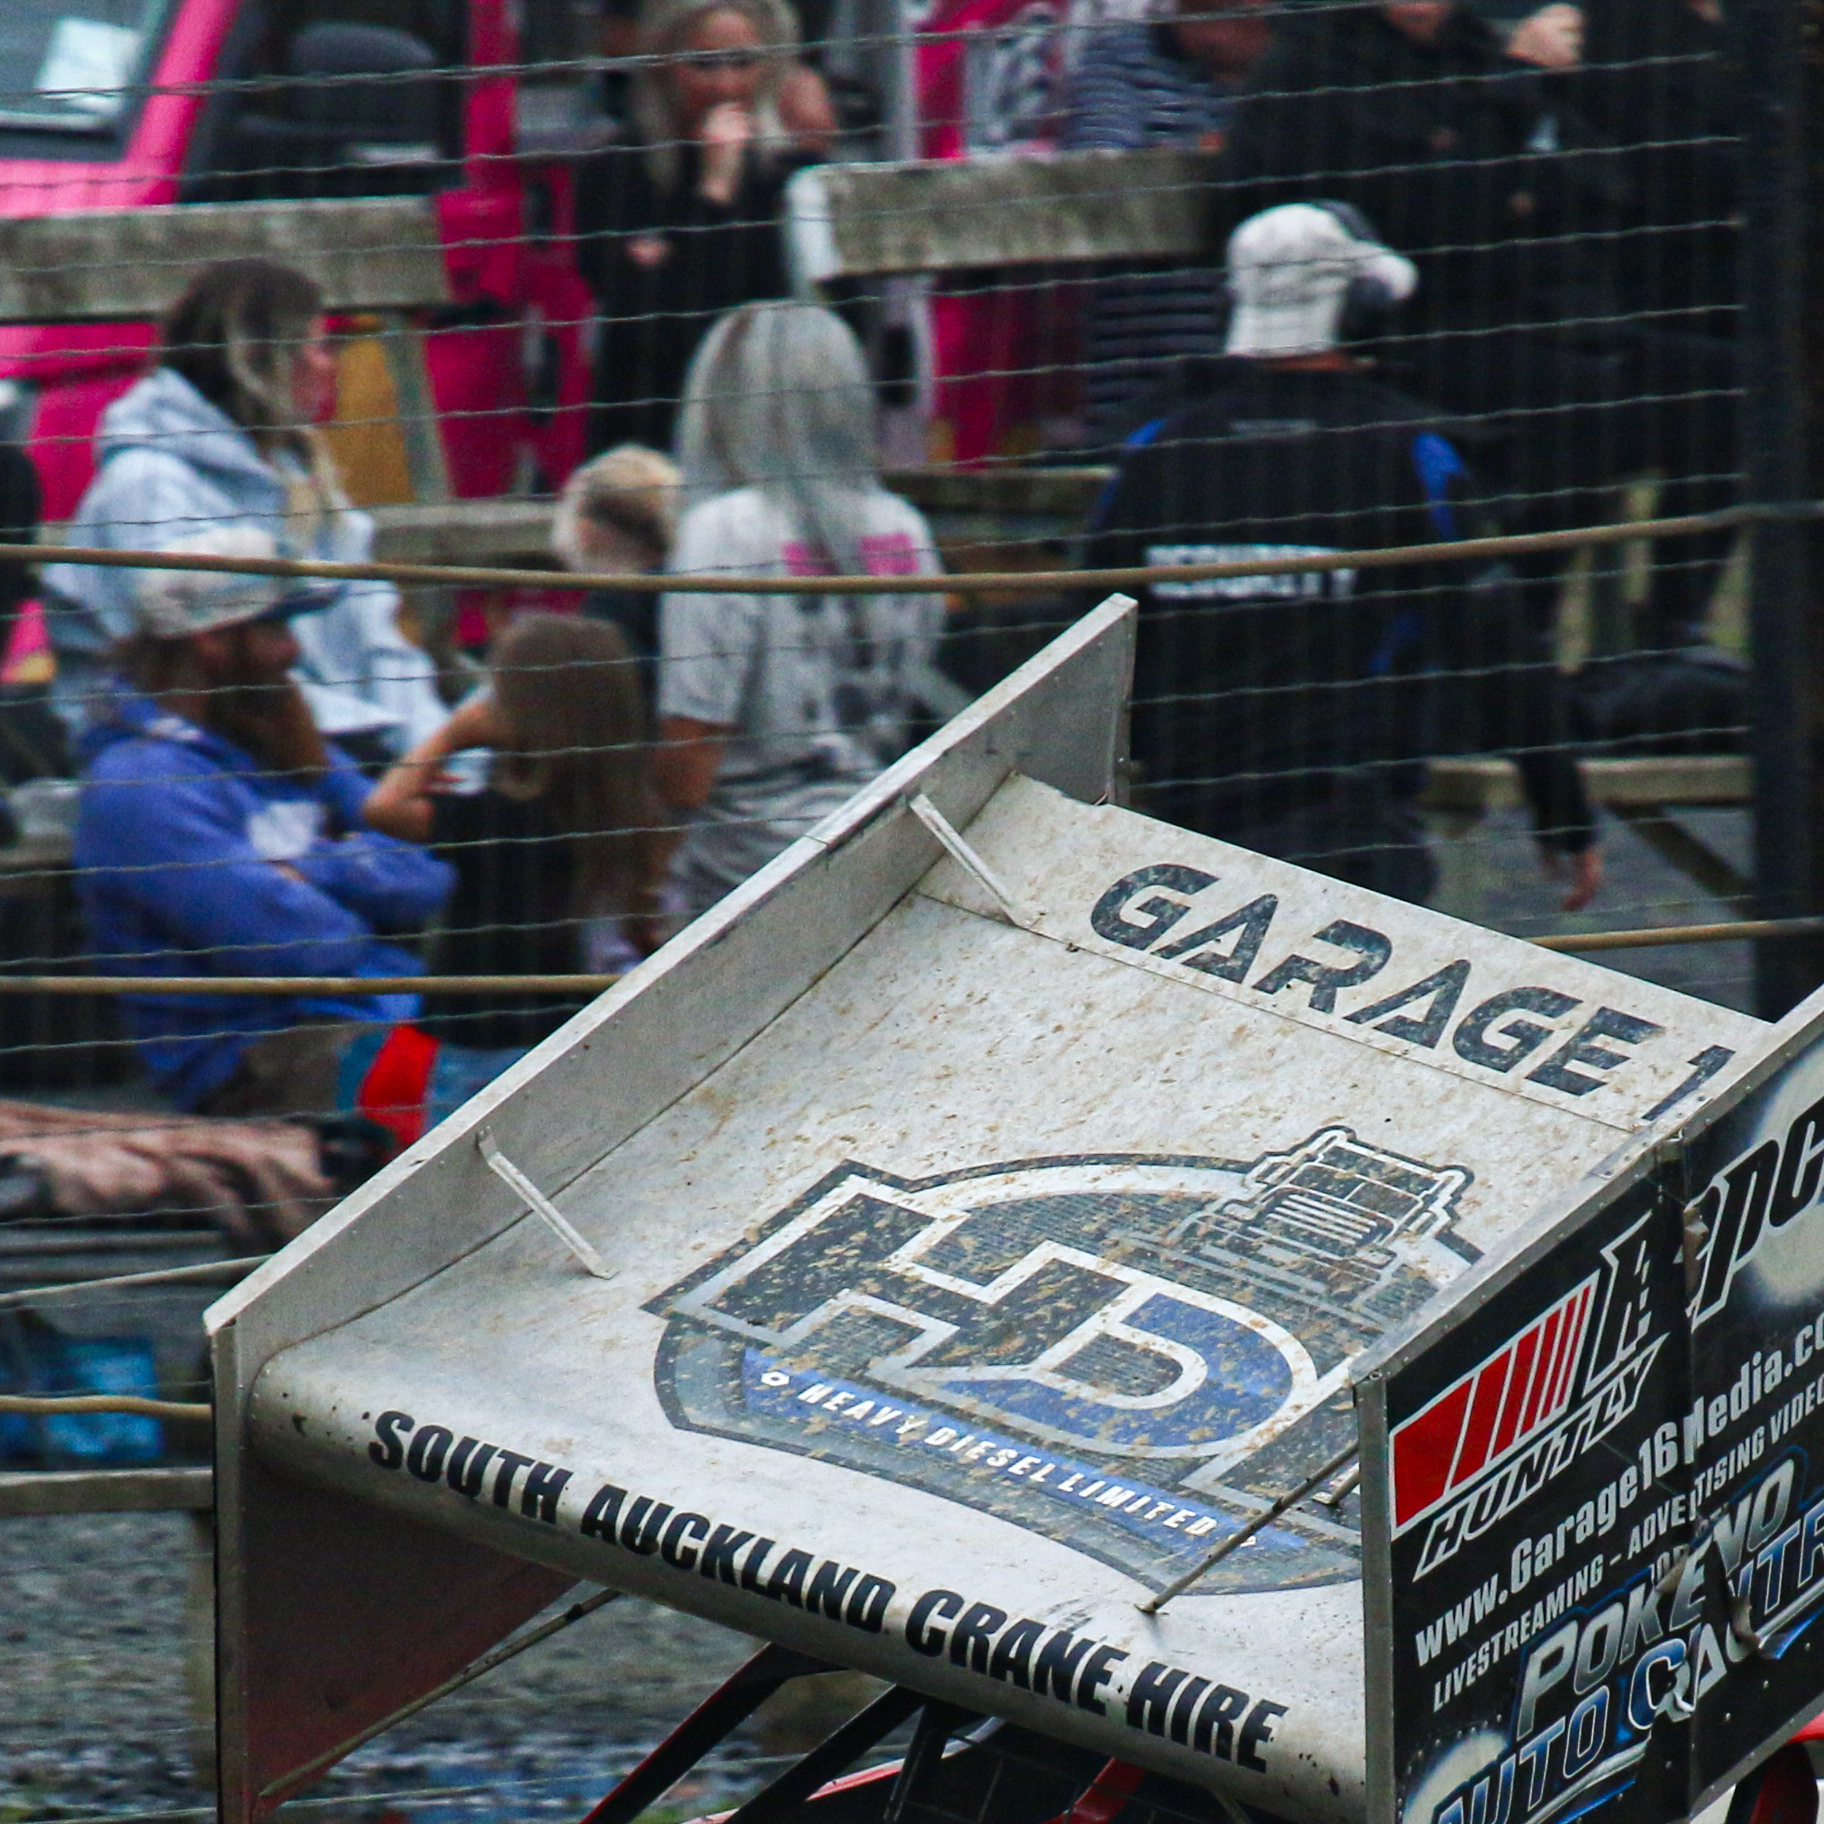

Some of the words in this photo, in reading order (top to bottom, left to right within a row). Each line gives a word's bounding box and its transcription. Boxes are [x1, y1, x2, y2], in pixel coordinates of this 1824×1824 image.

[1088, 861, 1666, 1099] GARAGE
[797, 1381, 929, 1436] HEAVY
[923, 1425, 1059, 1484] DIESEL
[1057, 1472, 1219, 1538] LIMITED
[1412, 1332, 1672, 1583] HUNTLY
[366, 1410, 575, 1524] SOUTH
[580, 1482, 895, 1634] AUCKLAND
[903, 1589, 1129, 1718] CRANE
[1123, 1660, 1288, 1774] HIRE
[1433, 1558, 1604, 1713] LIVESTREAMING
